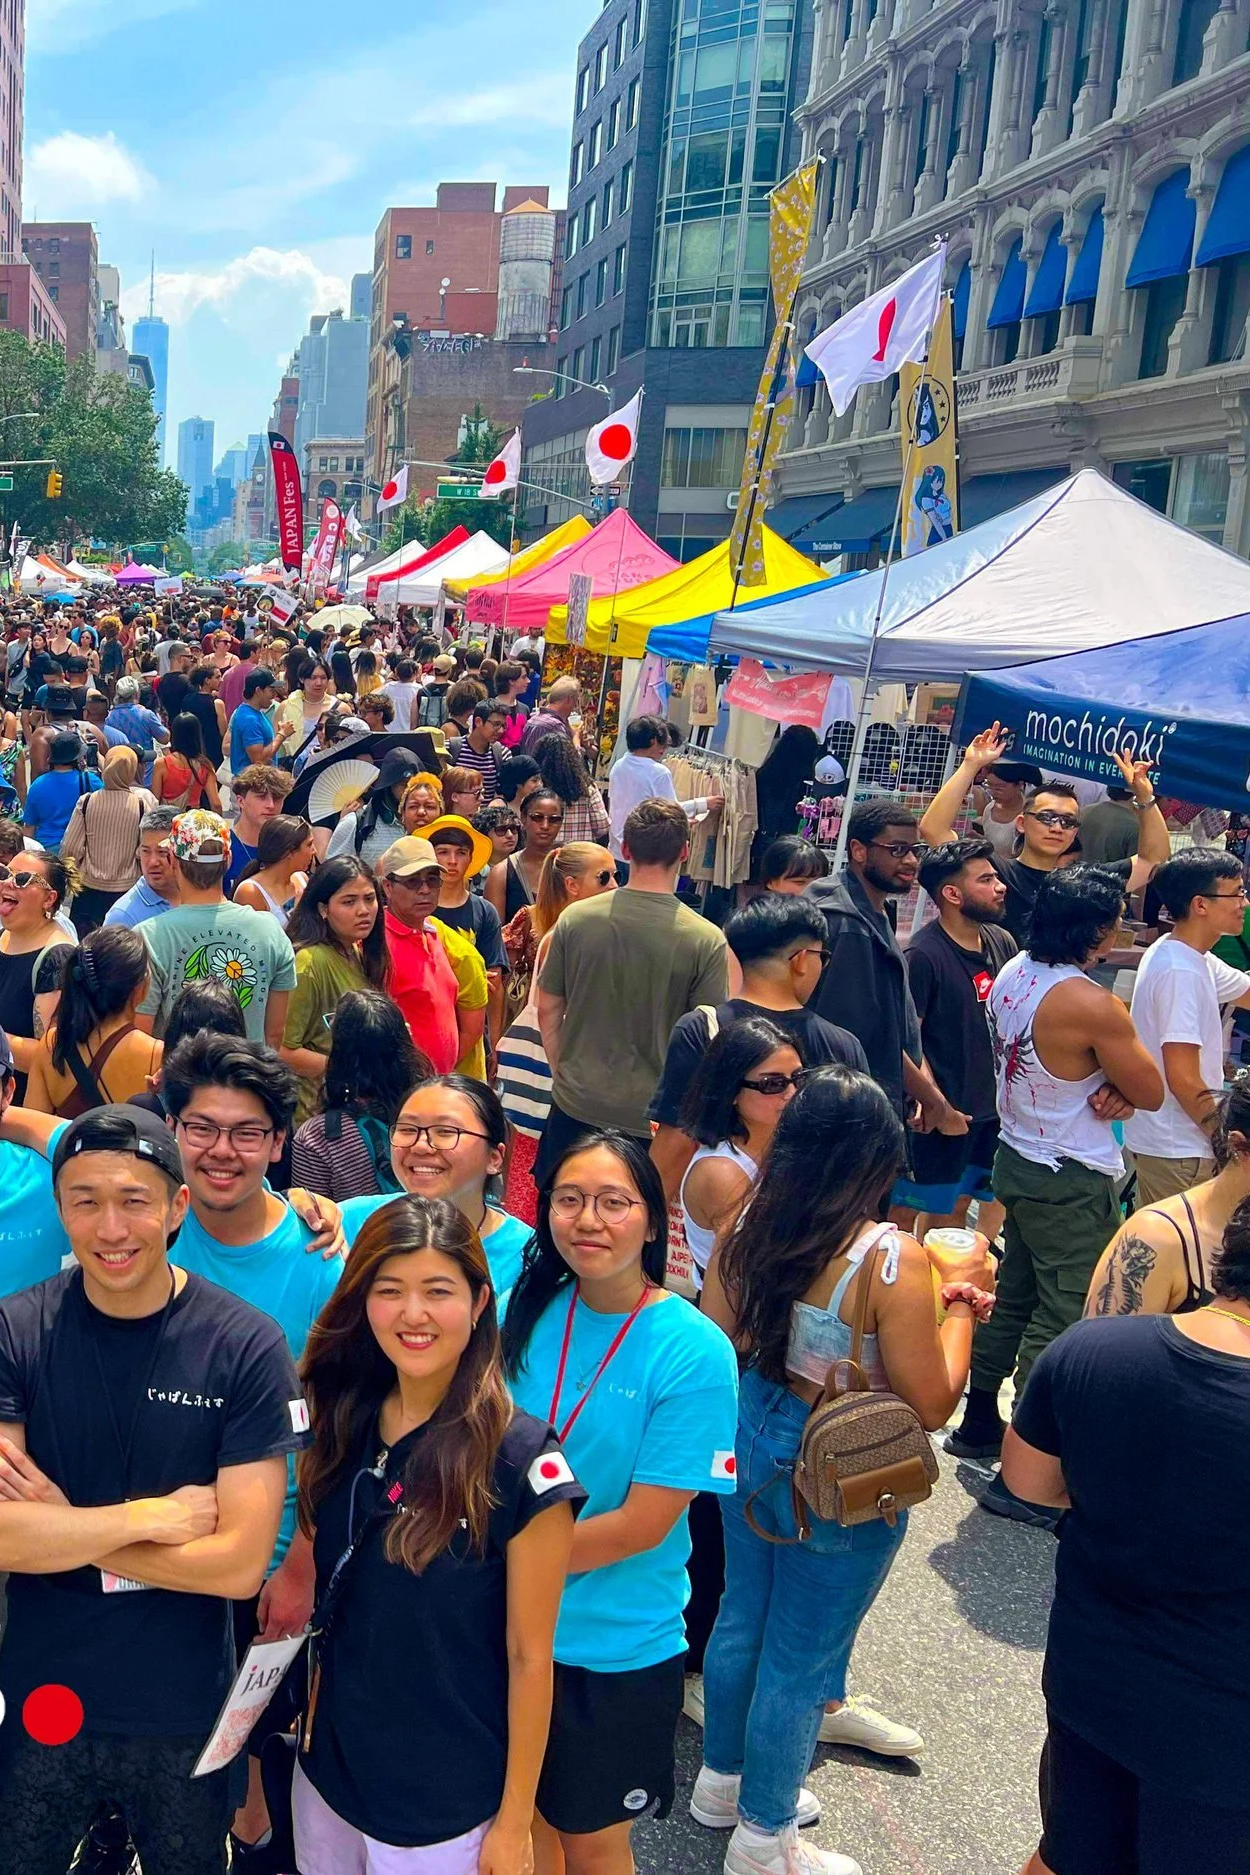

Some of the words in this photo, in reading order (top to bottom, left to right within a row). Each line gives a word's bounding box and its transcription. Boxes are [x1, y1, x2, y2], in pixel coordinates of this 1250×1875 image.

[456, 488, 462, 496] W
[464, 488, 470, 496] 18
[473, 488, 478, 496] S
[284, 508, 300, 555] JAPAN
[1023, 743, 1082, 769] IMAGINATION
[1084, 759, 1095, 772] IN
[1100, 764, 1124, 779] EVER
[192, 929, 256, 952] ELEVATED
[258, 960, 267, 1003] MINDS
